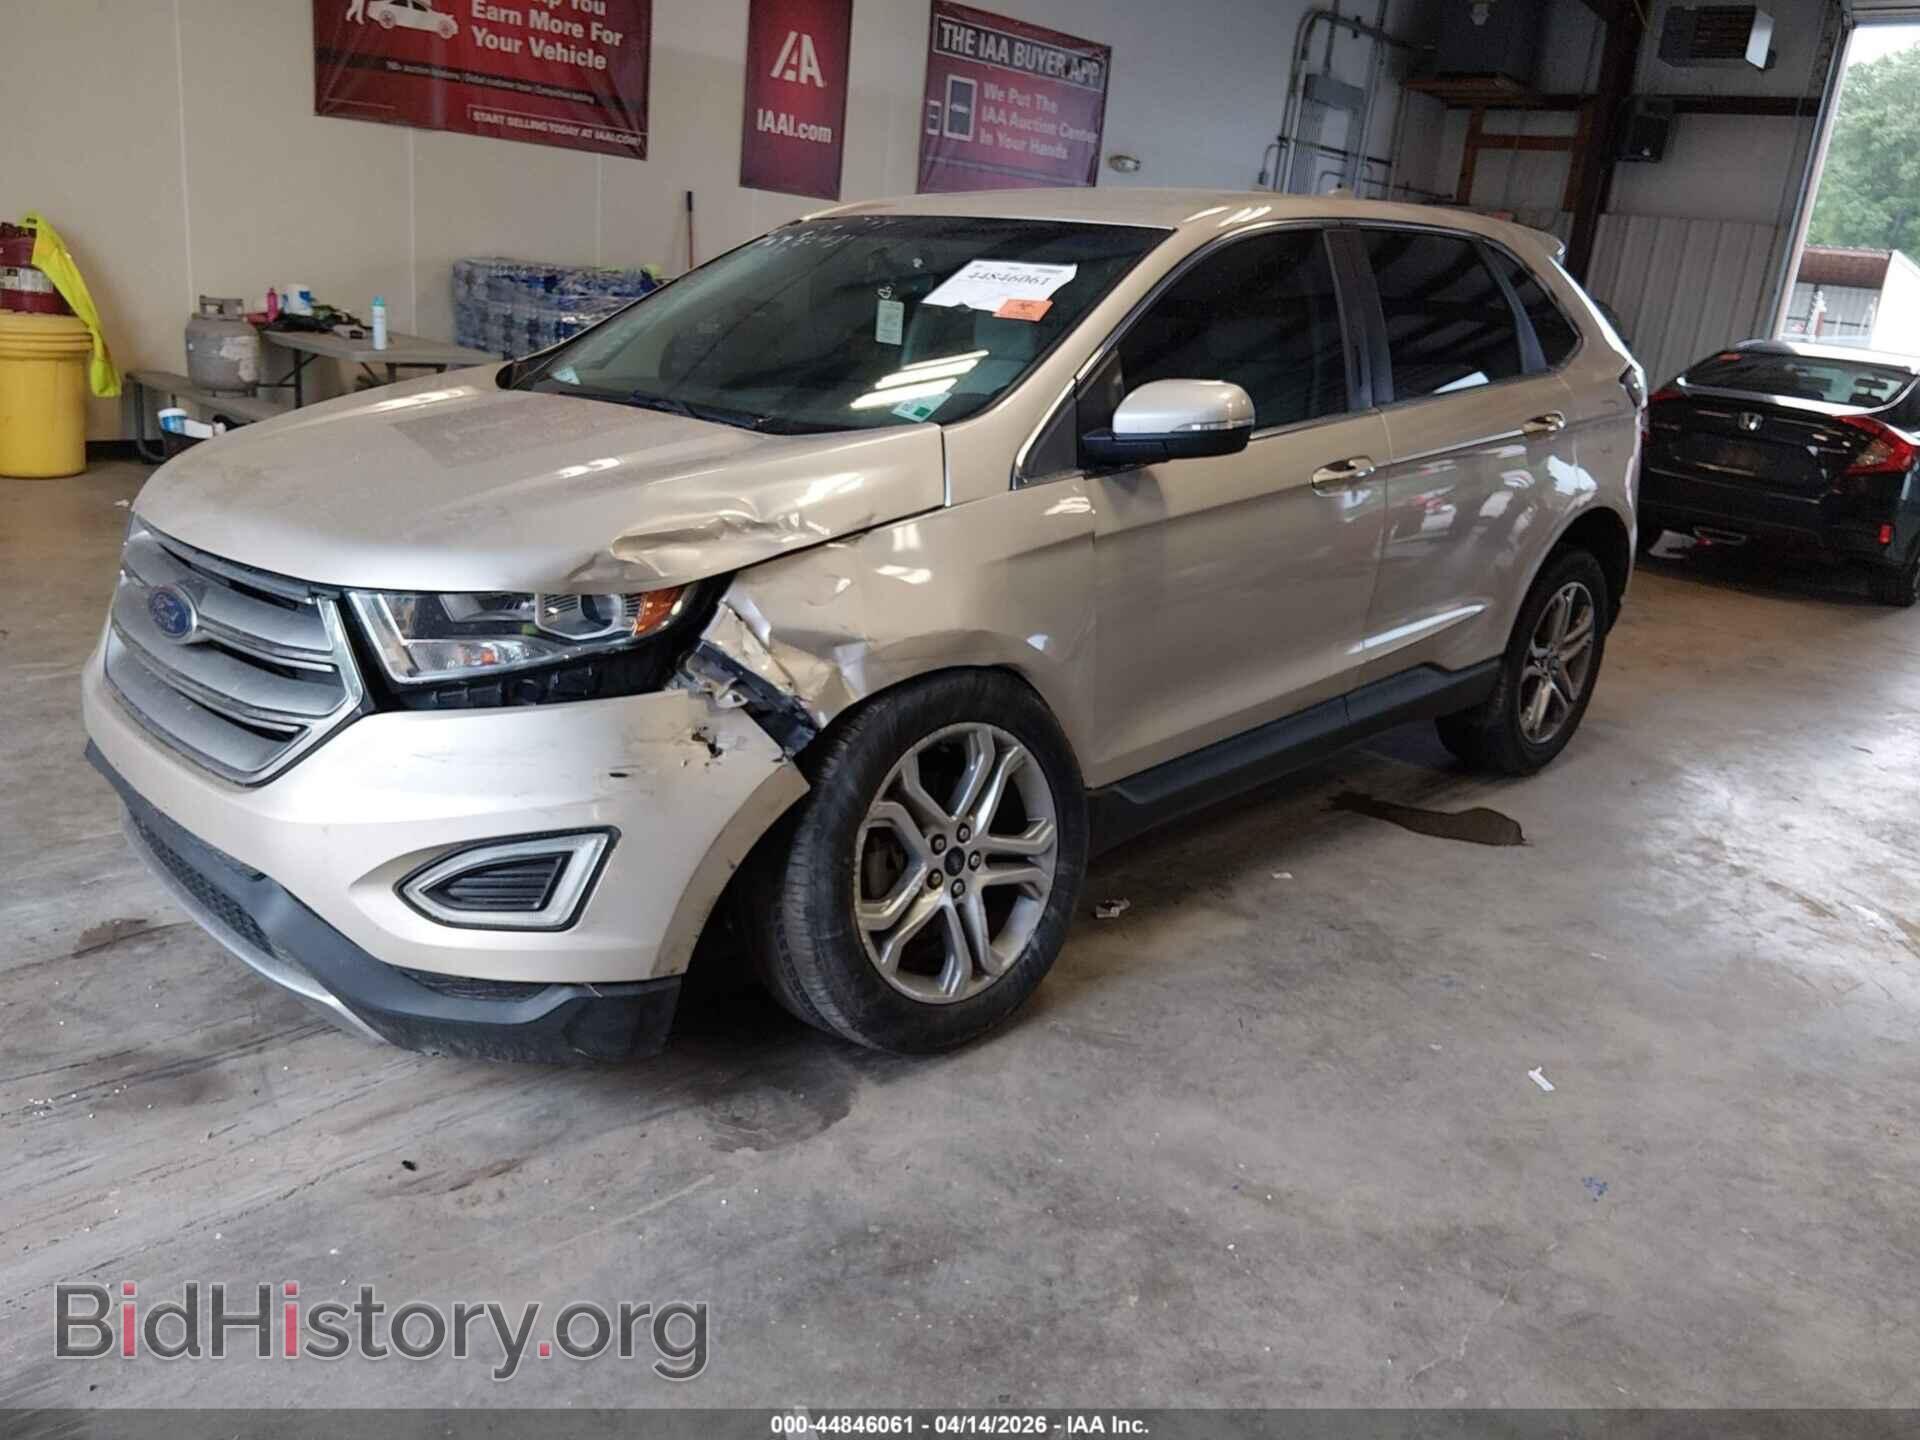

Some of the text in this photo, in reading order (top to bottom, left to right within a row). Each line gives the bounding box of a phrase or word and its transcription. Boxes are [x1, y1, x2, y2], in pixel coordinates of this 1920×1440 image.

[471, 0, 623, 46] Earn More For
[471, 25, 608, 70] Your Vehicle
[940, 21, 1101, 85] THE IAA BUYER APP
[983, 82, 1057, 114] We Put The
[472, 111, 504, 126] START
[757, 107, 832, 144] IAAI.com
[981, 105, 1007, 125] IAA
[1009, 111, 1056, 136] Auction
[979, 128, 1069, 160] In Your Hands
